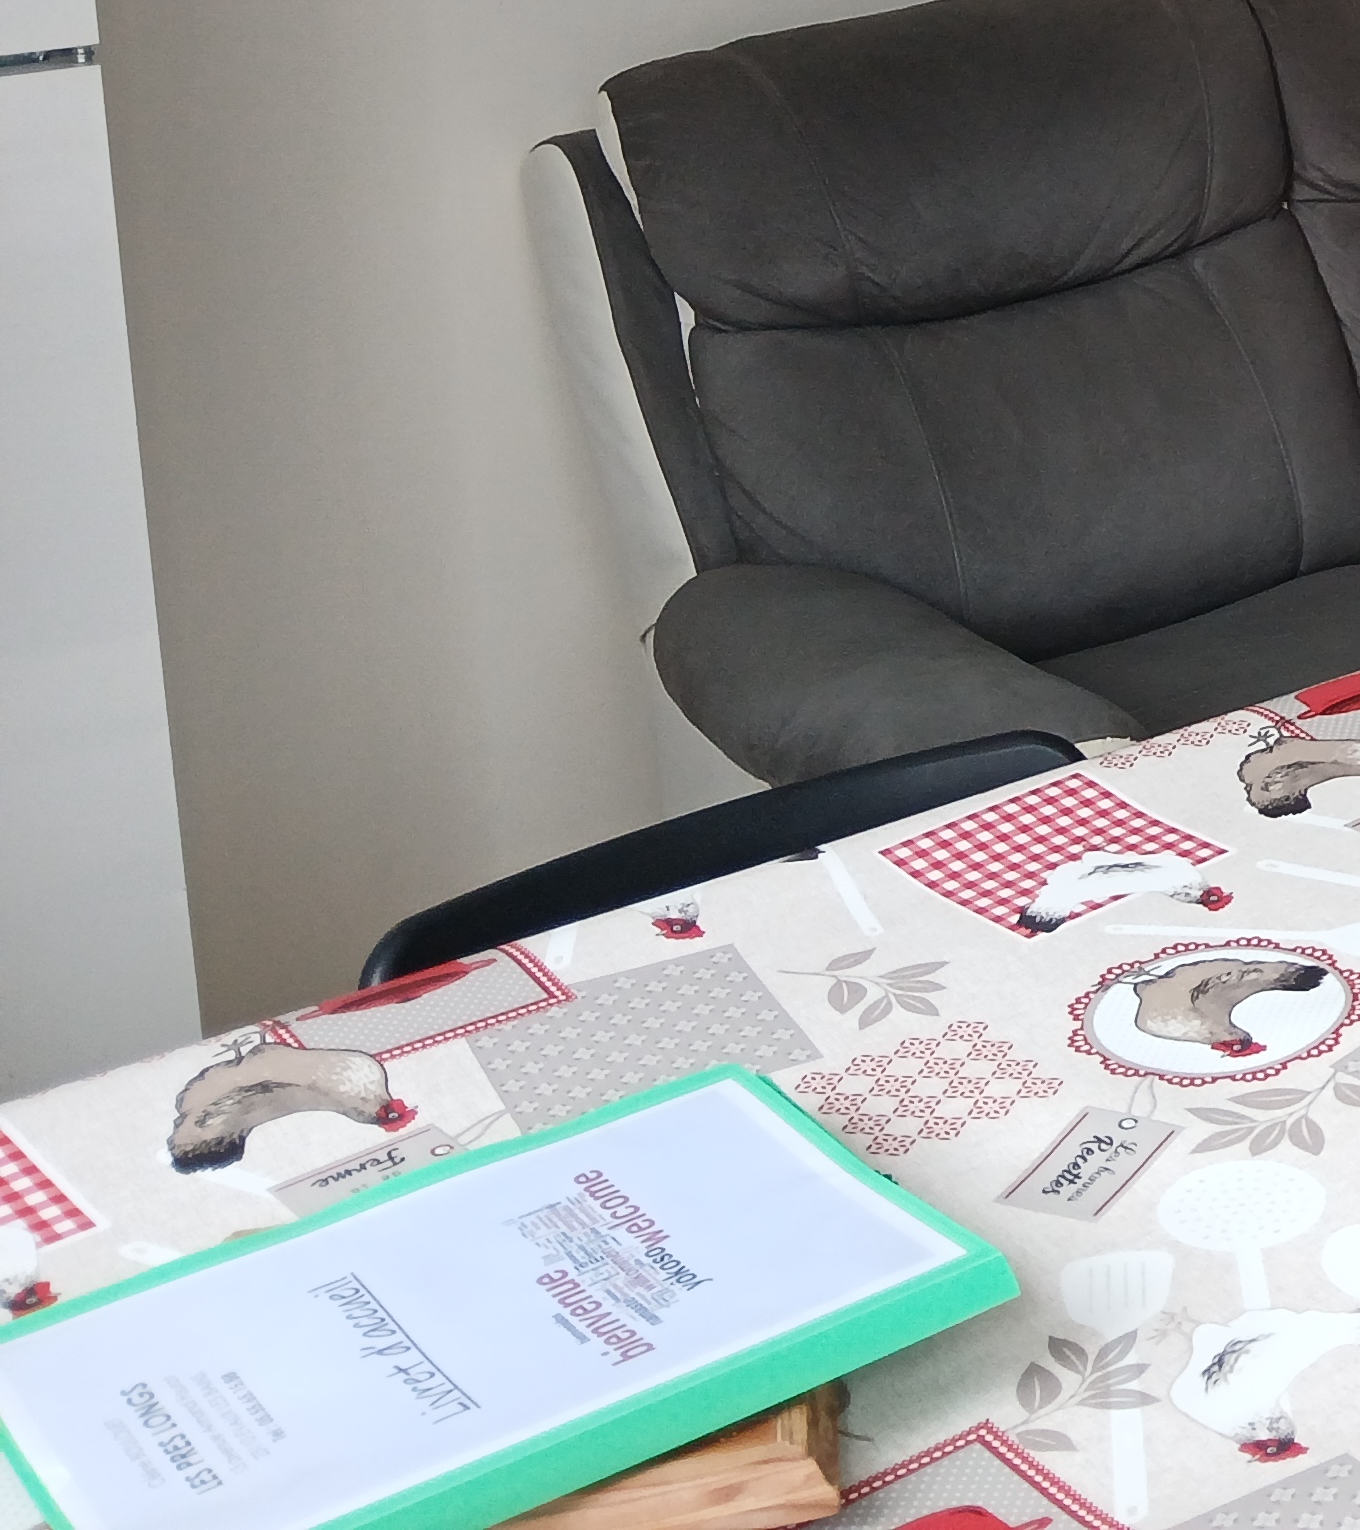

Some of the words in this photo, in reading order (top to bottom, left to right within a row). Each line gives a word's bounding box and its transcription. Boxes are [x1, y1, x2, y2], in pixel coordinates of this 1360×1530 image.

[310, 1147, 406, 1189] Ferme
[1041, 1135, 1114, 1196] Recettes
[1105, 1139, 1138, 1163] Les
[573, 1169, 671, 1250] welcome
[1066, 1166, 1116, 1202] bonnes
[306, 1275, 412, 1359] d'accueil
[535, 1268, 657, 1367] bienvenue
[119, 1381, 178, 1438] LONGS
[386, 1361, 472, 1425] Livret
[157, 1432, 205, 1472] PRES
[184, 1467, 224, 1496] LES
